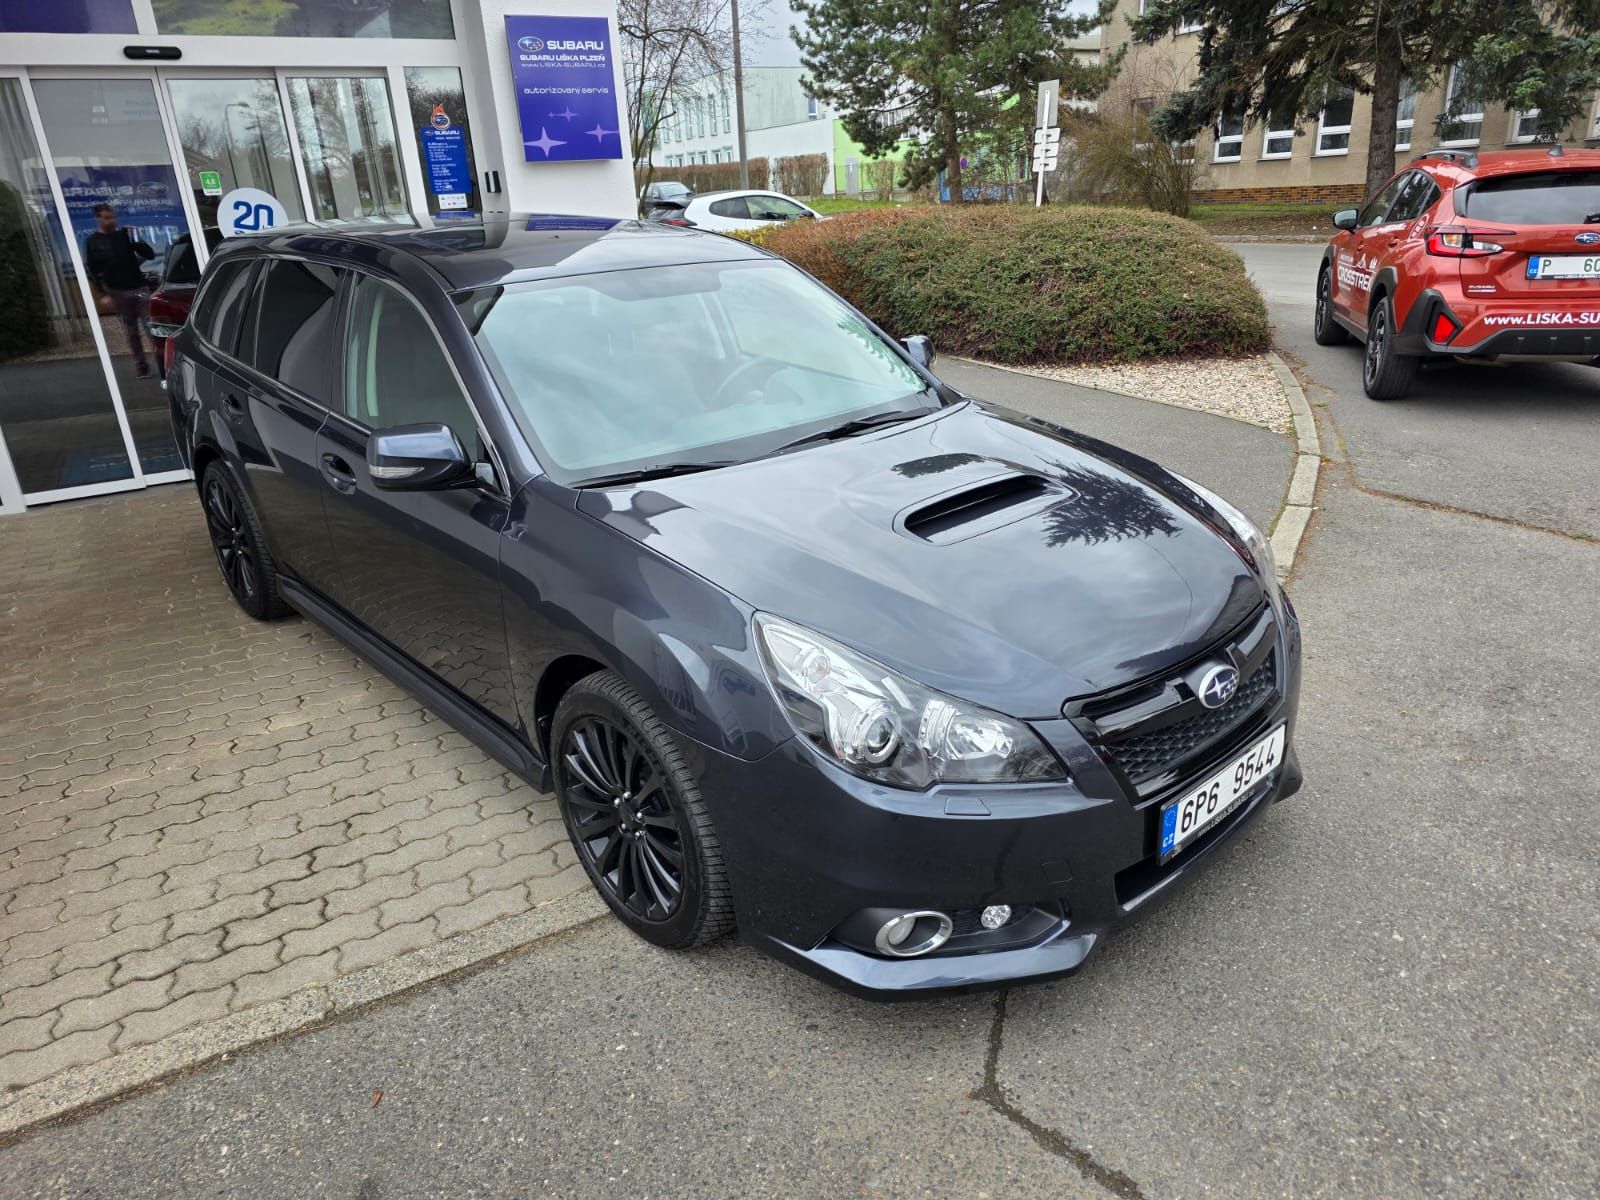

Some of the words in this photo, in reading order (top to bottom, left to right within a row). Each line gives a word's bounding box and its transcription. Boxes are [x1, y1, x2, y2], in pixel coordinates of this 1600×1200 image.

[546, 40, 604, 51] SUBARU
[1542, 259, 1552, 274] P
[1181, 781, 1220, 833] 6P6
[1233, 737, 1274, 794] 9544
[1162, 832, 1174, 848] CZ
